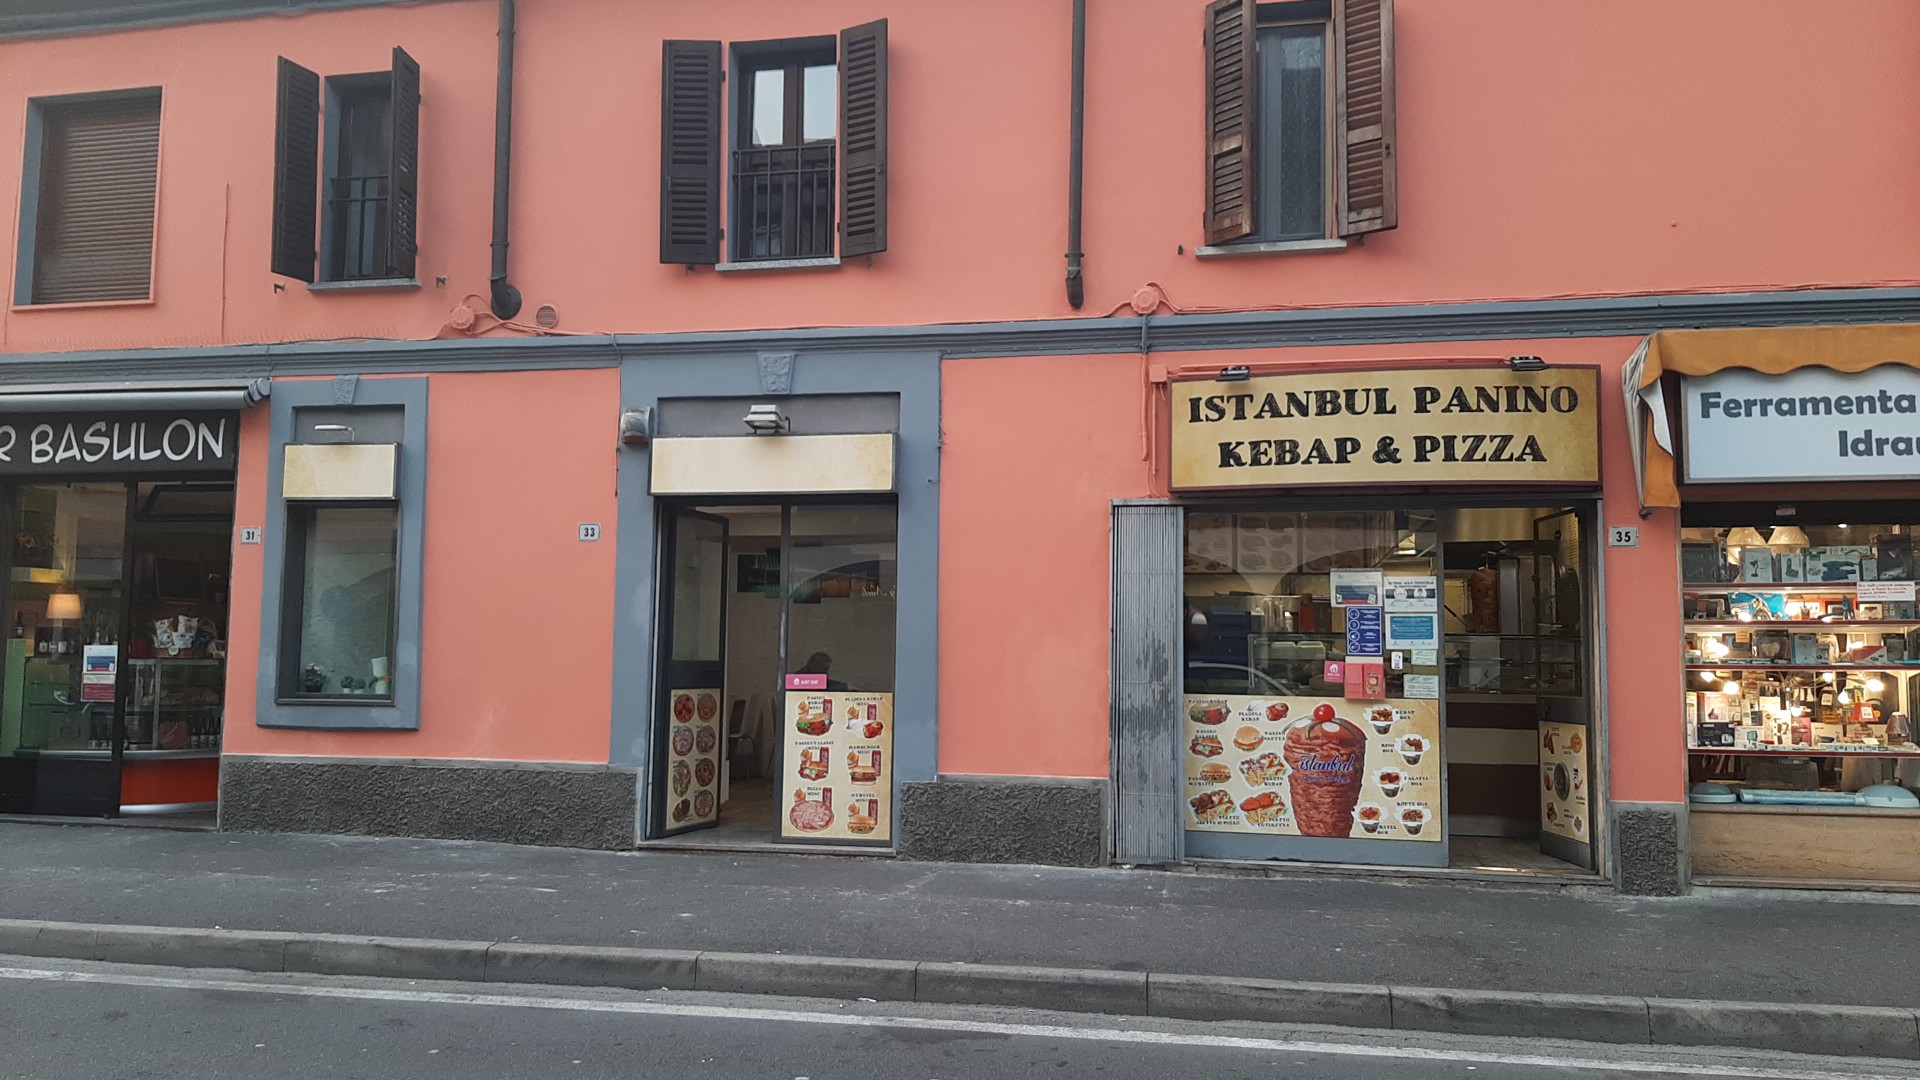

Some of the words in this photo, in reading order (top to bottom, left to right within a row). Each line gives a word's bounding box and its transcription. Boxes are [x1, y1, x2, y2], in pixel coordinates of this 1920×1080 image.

[1188, 387, 1396, 423] ISTANBUL
[1412, 385, 1579, 414] PANINO
[1700, 389, 1916, 419] Ferramenta
[31, 418, 226, 464] BASULON
[1218, 436, 1362, 468] KEBAP
[1372, 435, 1402, 464] &
[1413, 434, 1547, 463] PIZZA
[1838, 429, 1920, 457] Idra
[246, 531, 254, 540] 31
[584, 527, 595, 537] 33
[1616, 531, 1631, 542] 35
